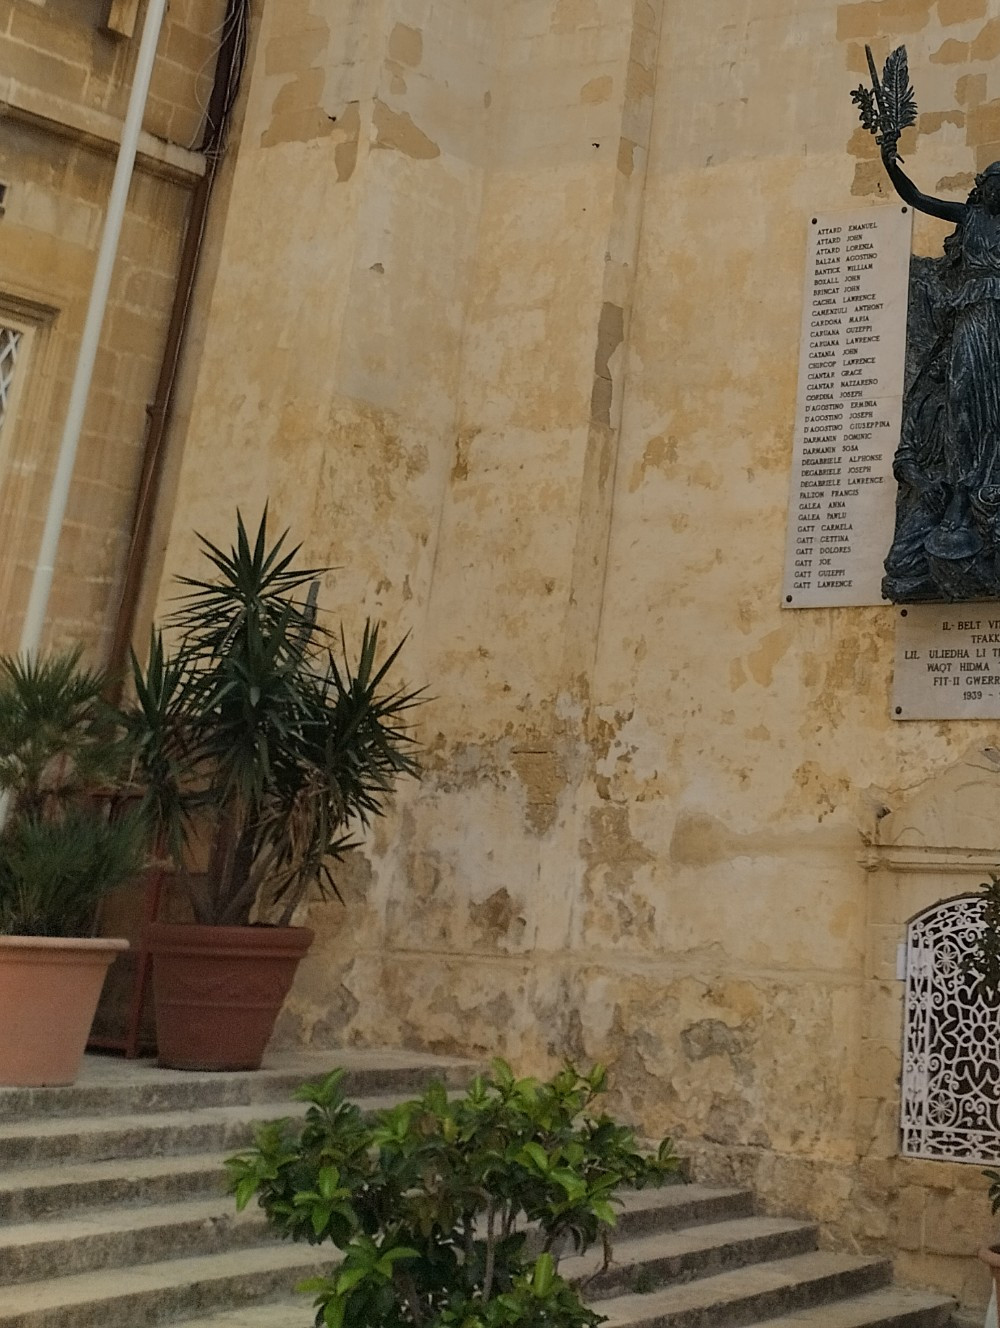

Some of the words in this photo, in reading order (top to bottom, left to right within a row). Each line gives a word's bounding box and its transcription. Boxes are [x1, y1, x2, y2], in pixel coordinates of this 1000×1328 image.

[817, 227, 842, 235] ATTARD
[848, 222, 877, 231] EMANUEL
[816, 237, 841, 245] ATTARD
[816, 247, 840, 255] ATTARD
[845, 243, 874, 251] LORENZA
[815, 257, 840, 265] BALZAN
[845, 252, 877, 261] AGOSTINO
[813, 288, 840, 296] BRINCAT
[842, 294, 876, 302] LAWRENCE
[854, 303, 883, 312] ANTHONY
[845, 335, 880, 344] LAWRENCE
[849, 411, 873, 419] JOSEPH
[848, 454, 882, 462] ALPHONSE
[847, 477, 885, 485] LAWRENCE
[820, 523, 853, 531] CARMELA
[819, 546, 851, 554] DOLORES
[958, 621, 981, 630] BELT
[929, 649, 969, 658] ULIEDHA
[976, 649, 986, 657] LI
[927, 663, 951, 673] WAQT
[933, 677, 959, 686] FIT-II
[963, 691, 982, 700] 1939
